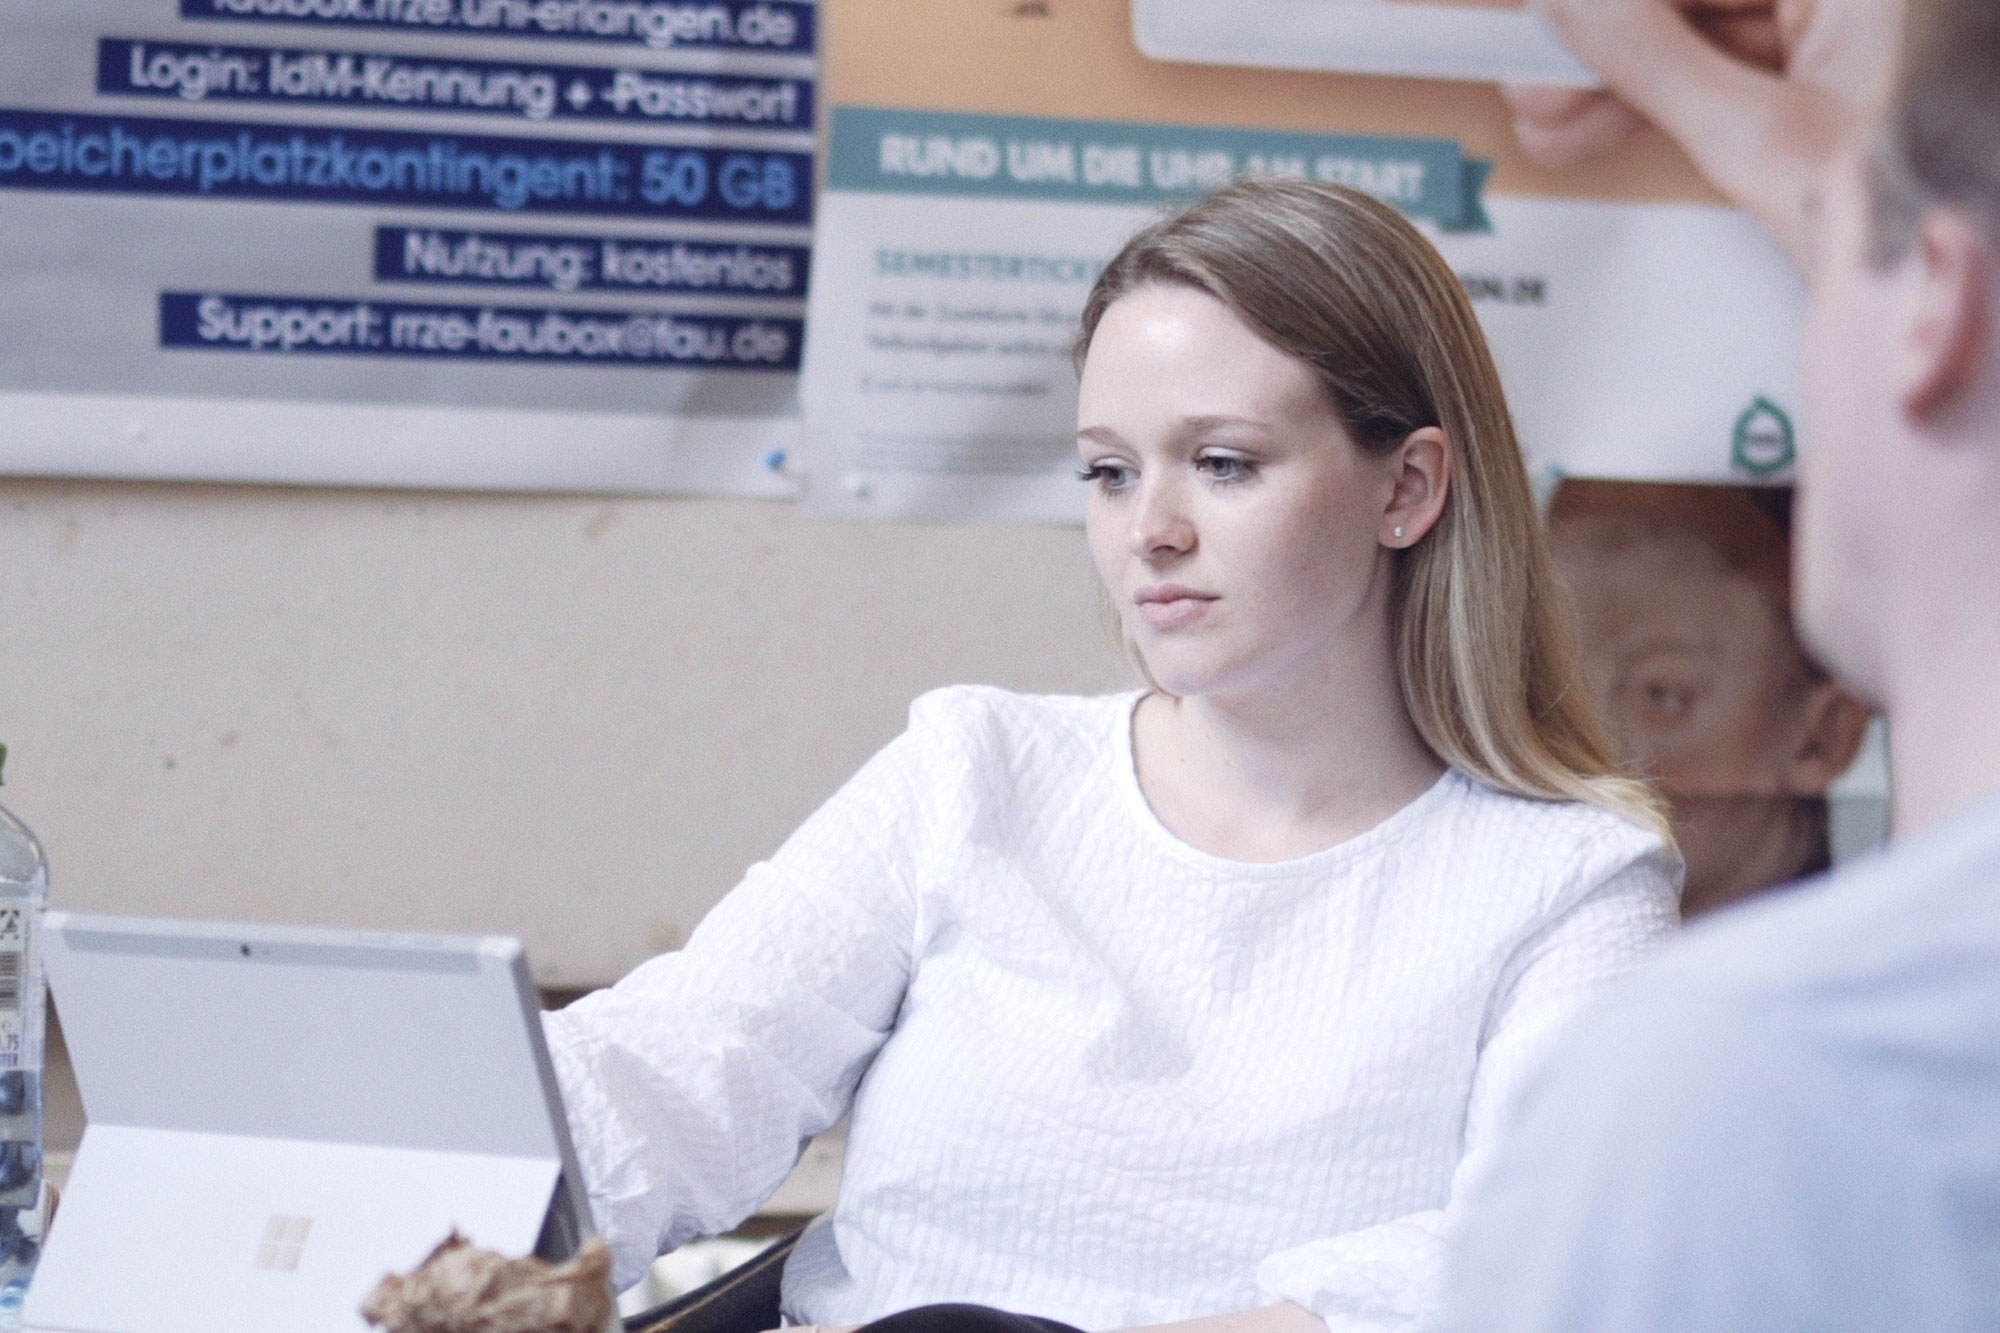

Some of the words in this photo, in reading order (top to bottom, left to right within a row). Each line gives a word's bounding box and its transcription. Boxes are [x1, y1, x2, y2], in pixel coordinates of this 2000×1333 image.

[131, 43, 261, 99] Login:
[269, 52, 556, 119] IdM-Kennung
[566, 80, 593, 110] +
[603, 70, 797, 122] -Passwort
[0, 122, 630, 209] peicherplatzkontingent:
[641, 150, 709, 205] 50
[719, 155, 797, 210] GB
[881, 135, 999, 180] RUND
[1006, 142, 1075, 182] UM
[1082, 147, 1143, 188] DIE
[1151, 150, 1233, 189] UHR
[1315, 157, 1423, 199] START
[404, 232, 596, 291] Nutzung:
[602, 241, 794, 289] kostenlos
[198, 296, 384, 352] Support:
[391, 311, 789, 362] rrze-faubox@fau.de
